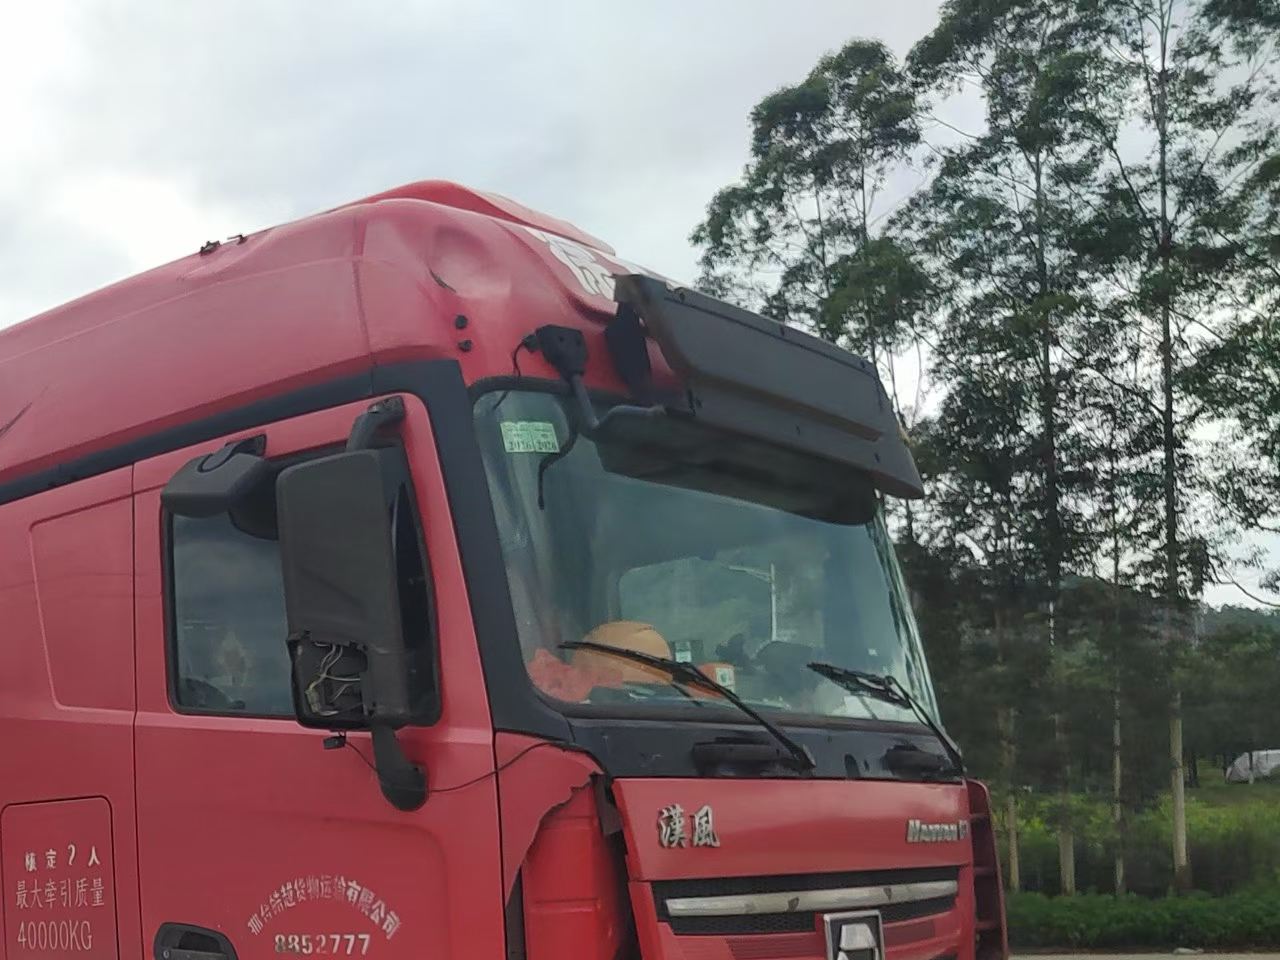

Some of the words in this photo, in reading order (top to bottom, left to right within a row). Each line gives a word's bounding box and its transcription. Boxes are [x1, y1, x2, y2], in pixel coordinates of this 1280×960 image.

[658, 803, 721, 848] 漢風
[16, 877, 105, 909] 最大牵引质量
[17, 919, 92, 951] 40000KG
[274, 933, 371, 955] 8852777
